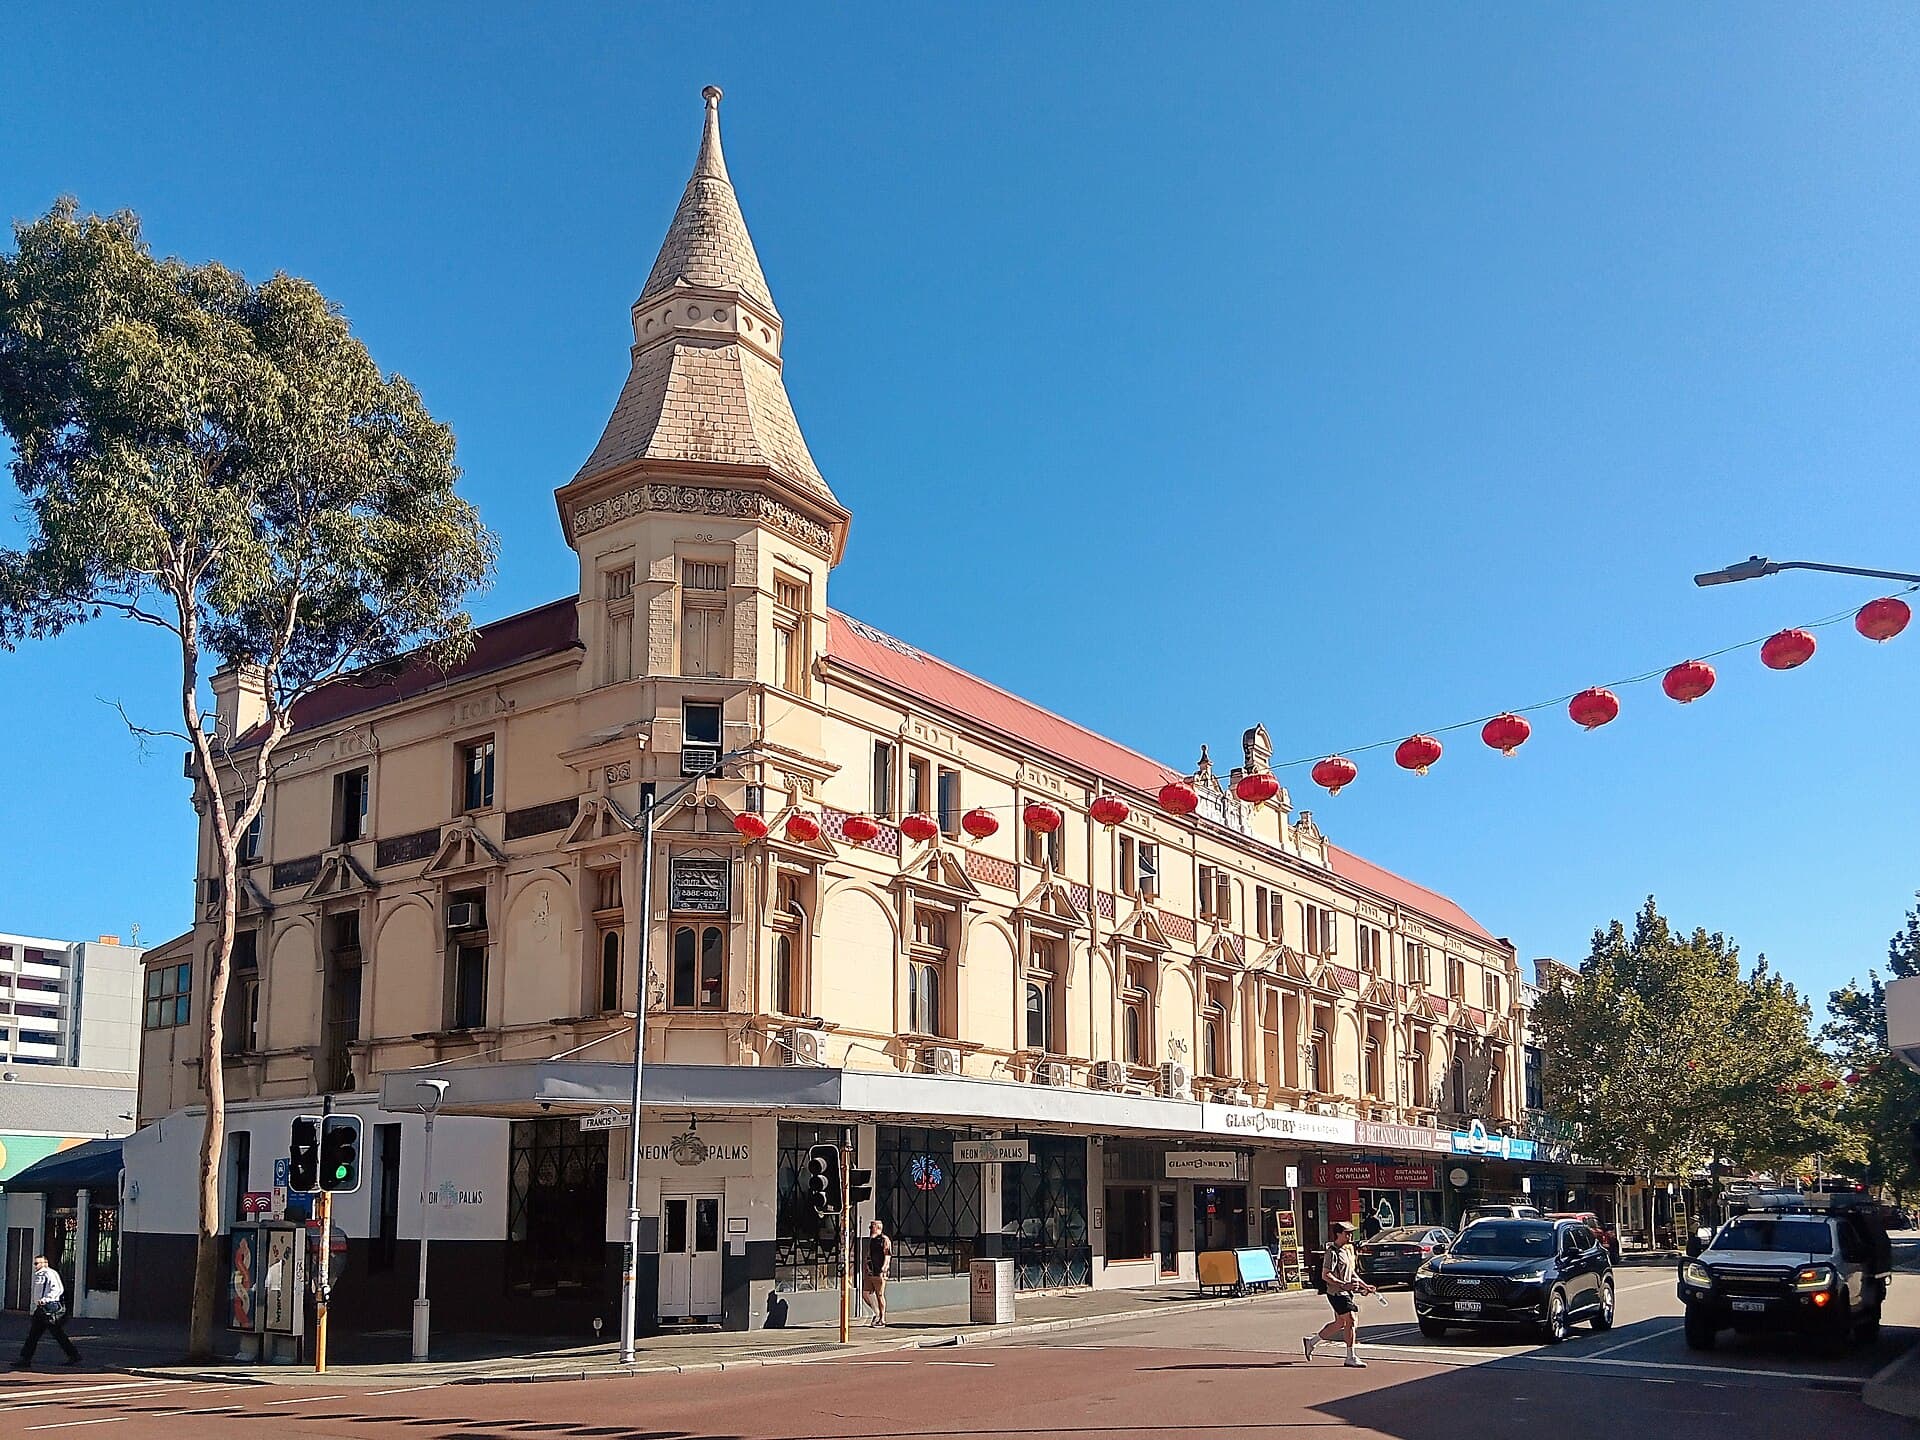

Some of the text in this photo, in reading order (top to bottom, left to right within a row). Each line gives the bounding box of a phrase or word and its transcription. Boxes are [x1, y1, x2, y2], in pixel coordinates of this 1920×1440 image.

[586, 1117, 611, 1127] FRANCIS
[709, 1144, 749, 1160] PALMS
[960, 1147, 1023, 1159] NEON PALMS
[458, 1190, 483, 1204] PALMS
